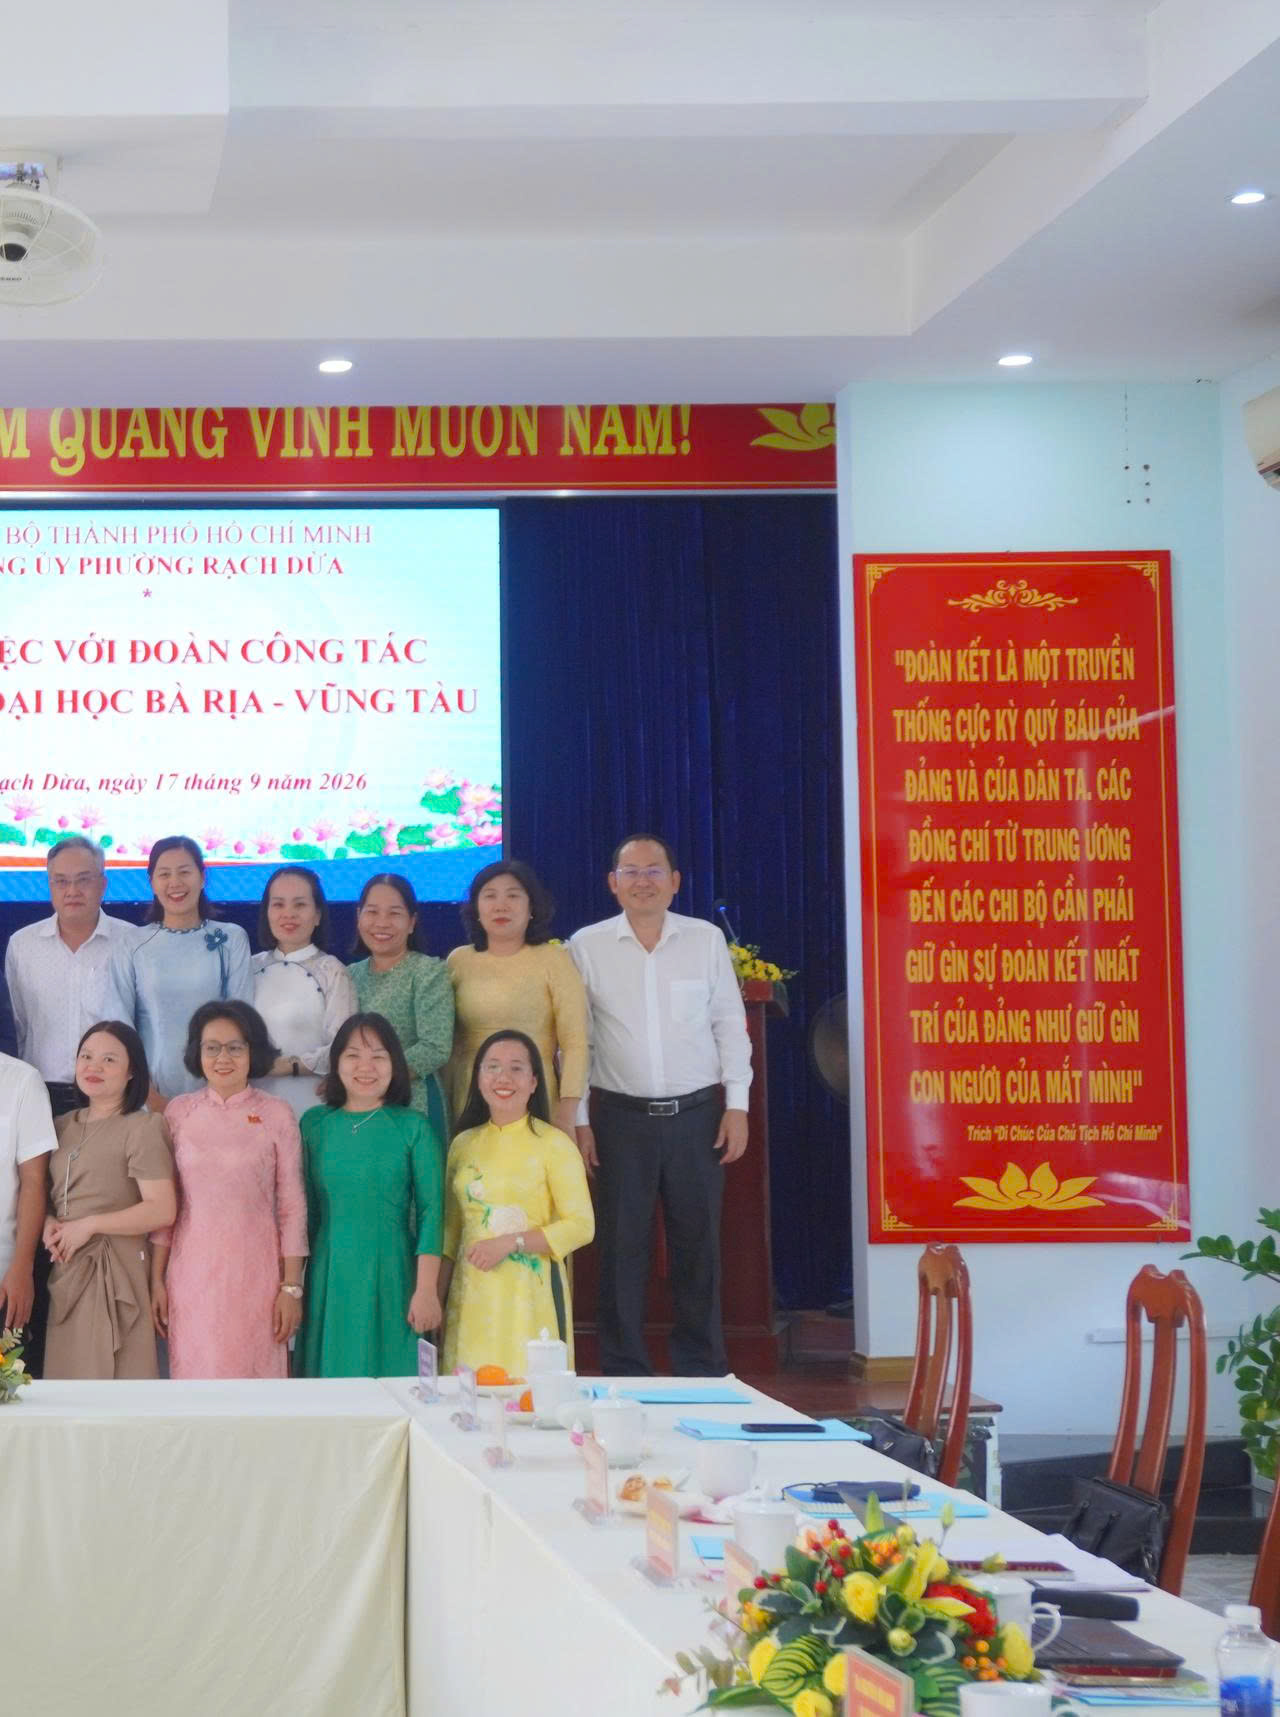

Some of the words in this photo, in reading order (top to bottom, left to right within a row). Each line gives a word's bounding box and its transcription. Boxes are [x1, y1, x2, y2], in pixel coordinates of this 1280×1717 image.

[49, 407, 228, 476] QUANG
[247, 406, 373, 458] VINH
[6, 520, 41, 549] BỘ
[48, 520, 138, 545] THÀNH
[250, 520, 294, 544] CHÍ
[303, 525, 371, 544] MINH
[79, 552, 194, 576] PHƯỜNG
[203, 556, 278, 580] RẠCH
[286, 550, 344, 575] DỪA
[53, 632, 118, 664] VỚI
[129, 632, 230, 664] ĐOÀN
[240, 630, 345, 664] CÔNG
[354, 631, 428, 664] TÁC
[956, 636, 991, 682] KẾT
[996, 640, 1018, 682] LÀ
[1024, 639, 1060, 688] MỘT
[1065, 633, 1134, 681] TRUYỀN
[56, 689, 134, 720] HỌC
[145, 682, 191, 714] BÀ
[203, 689, 265, 720] RỊA
[294, 682, 396, 714] VŨNG
[406, 681, 478, 714] TÀU
[892, 696, 952, 742] THỐNG
[956, 702, 990, 748] CỰC
[996, 698, 1018, 742] KỲ
[1024, 698, 1058, 747] QUÝ
[1064, 698, 1100, 741] BÁU
[1104, 694, 1140, 741] CỦA
[42, 772, 91, 793] Dừa,
[98, 774, 148, 794] ngày
[156, 772, 178, 790] 17
[184, 772, 243, 794] tháng
[249, 773, 262, 791] 9
[268, 774, 312, 791] năm
[318, 772, 368, 791] 2026
[905, 756, 952, 802] ĐẢNG
[956, 760, 980, 802] VÀ
[984, 756, 1020, 802] CỦA
[1024, 759, 1060, 801] DÂN
[1096, 758, 1132, 801] CÁC
[909, 815, 956, 862] ĐỒNG
[960, 820, 990, 862] CHÍ
[994, 820, 1019, 862] TỪ
[1022, 828, 1080, 862] TRUNG
[1084, 822, 1132, 862] ƯƠNG
[909, 876, 946, 922] ĐẾN
[950, 880, 985, 922] CÁC
[989, 888, 1019, 922] CHI
[1023, 880, 1048, 929] BỘ
[1052, 874, 1088, 922] CẦN
[1093, 874, 1134, 922] PHẢI
[906, 941, 936, 983] GIỮ
[940, 940, 969, 983] GÌN
[974, 943, 998, 990] SỰ
[1001, 940, 1049, 983] ĐOÀN
[1054, 936, 1088, 982] KẾT
[1094, 935, 1140, 982] NHẤT
[910, 1000, 940, 1044] TRÍ
[944, 996, 980, 1044] CỦA
[984, 996, 1032, 1044] ĐẢNG
[1036, 1002, 1072, 1043] NHƯ
[1076, 1001, 1106, 1043] GIỮ
[1110, 1000, 1140, 1042] GÌN
[910, 1070, 945, 1104] CON
[1006, 1057, 1042, 1104] CỦA
[1046, 1055, 1083, 1104] MẮT
[967, 1124, 992, 1142] Trích
[1010, 1124, 1034, 1142] Chúc
[1036, 1122, 1056, 1142] Của
[1078, 1124, 1100, 1146] Tịch
[1116, 1124, 1134, 1142] Chí
